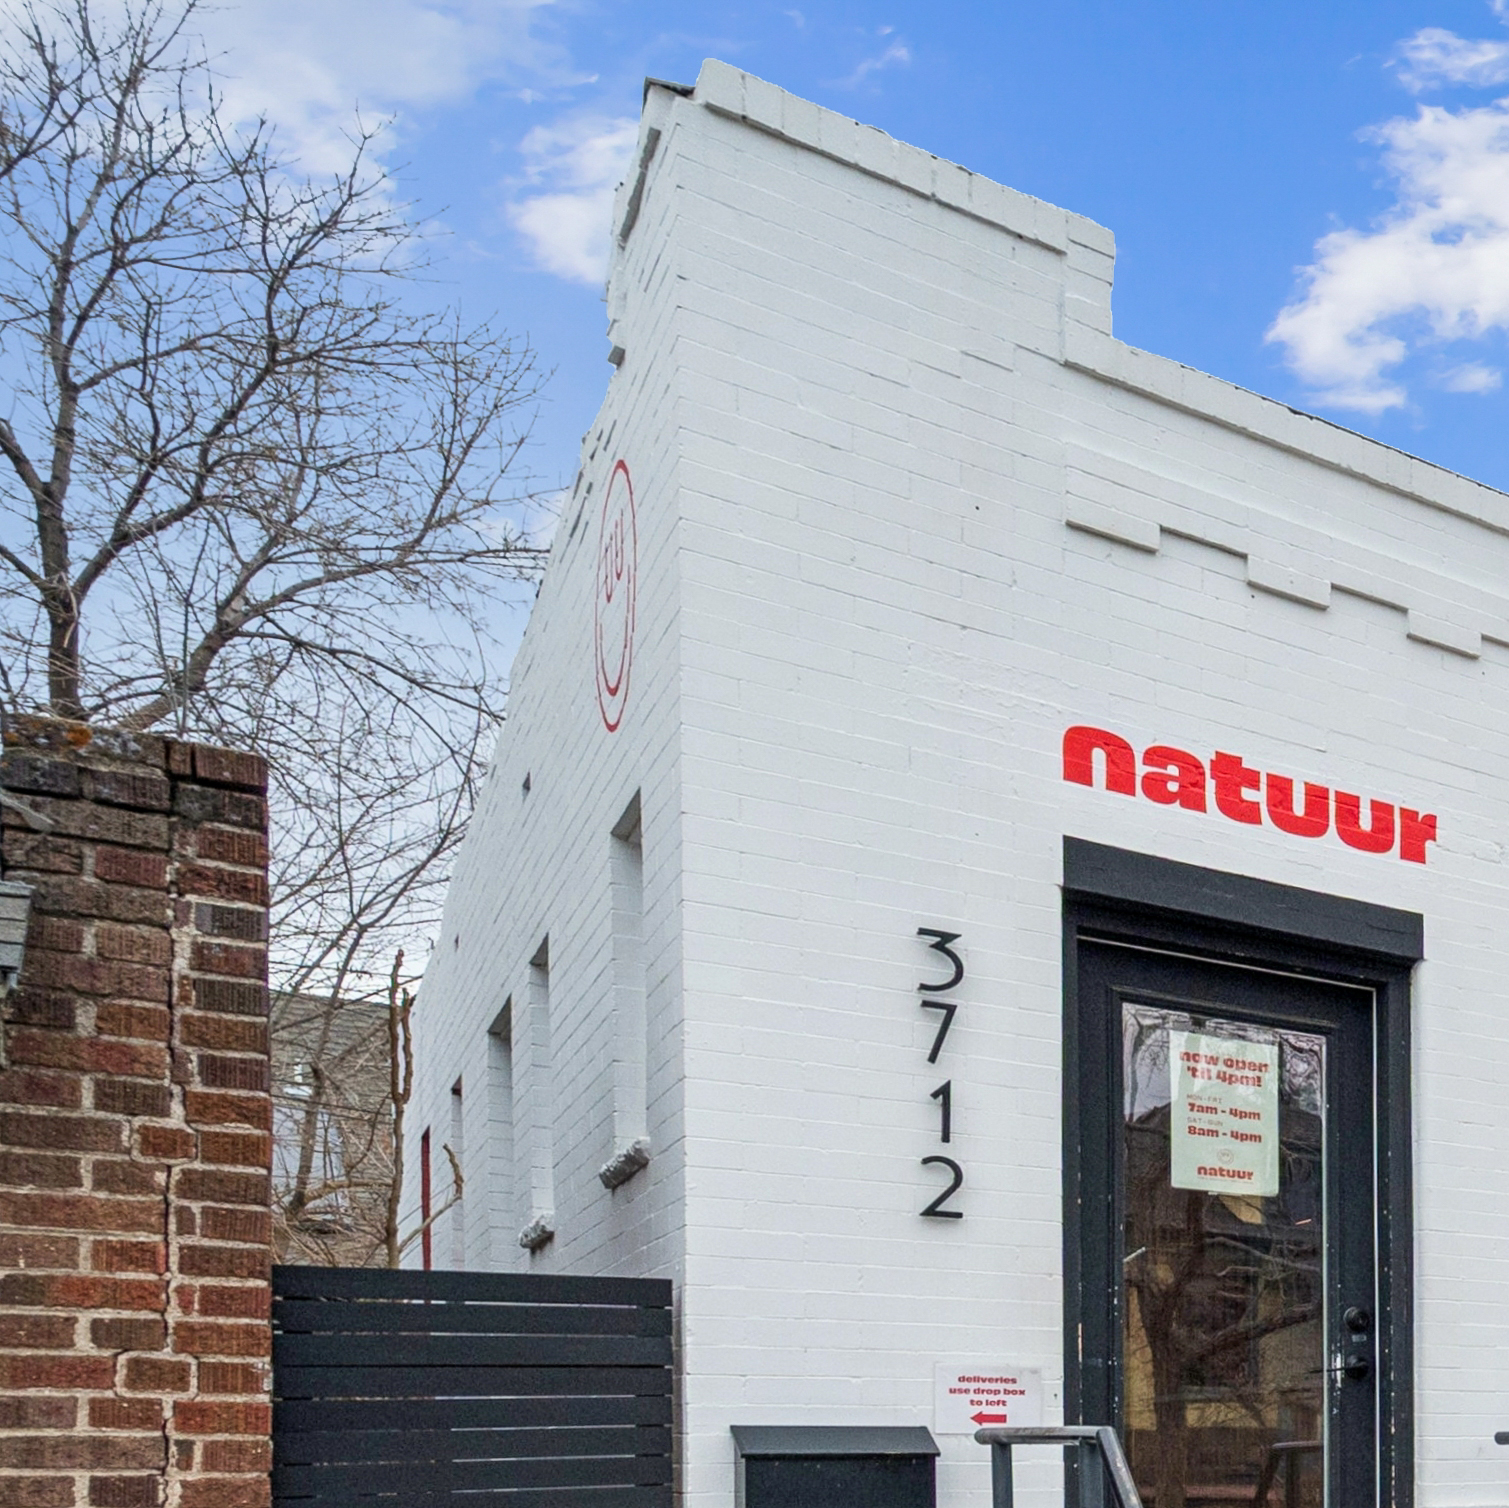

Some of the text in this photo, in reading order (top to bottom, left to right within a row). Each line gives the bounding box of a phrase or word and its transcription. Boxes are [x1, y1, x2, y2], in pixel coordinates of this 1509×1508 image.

[1061, 725, 1438, 864] natuur
[1180, 1051, 1270, 1073] now open
[916, 926, 964, 1220] 3712
[1215, 1070, 1263, 1088] 4pm!
[1188, 1102, 1218, 1115] 7am
[1229, 1108, 1261, 1121] 4pm
[1187, 1125, 1219, 1138] 8am
[1230, 1130, 1262, 1143] 4pm
[1197, 1166, 1254, 1181] natuur
[957, 1375, 1018, 1384] deliveries
[948, 1387, 1026, 1396] use drop box
[985, 1398, 1007, 1407] left
